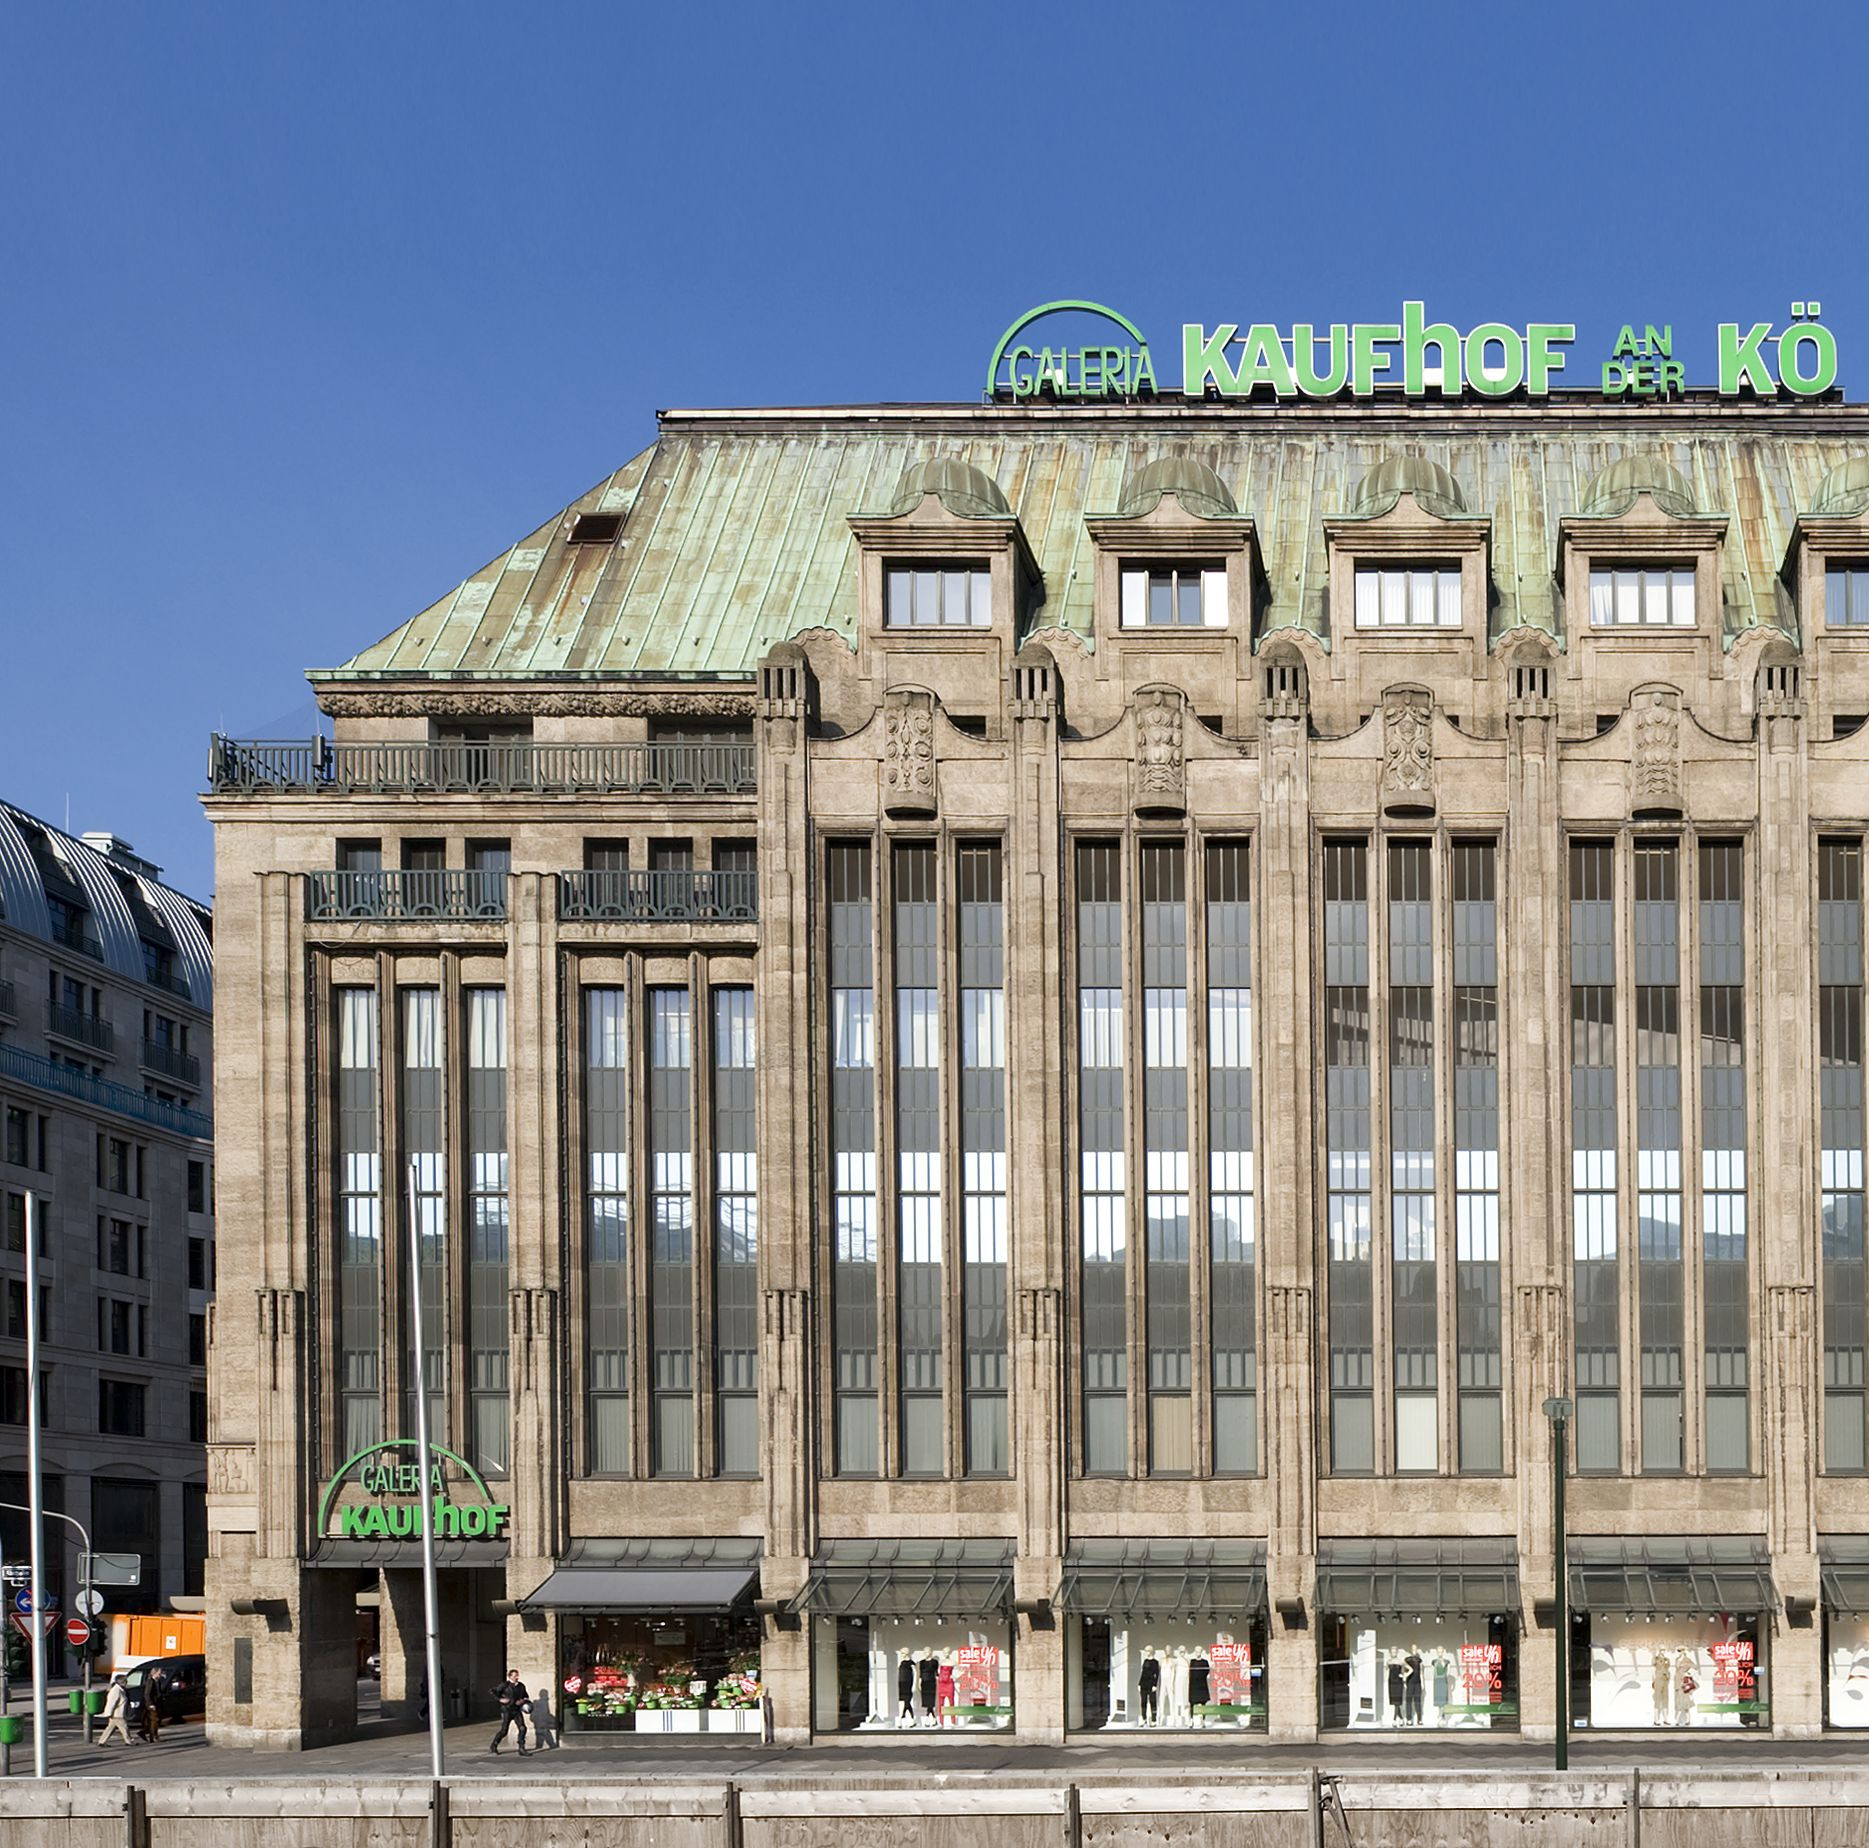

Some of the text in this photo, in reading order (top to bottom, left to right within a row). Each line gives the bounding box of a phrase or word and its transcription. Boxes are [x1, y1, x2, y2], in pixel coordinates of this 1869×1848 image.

[1612, 324, 1672, 357] AN
[1718, 301, 1838, 396] KÖ
[1009, 345, 1158, 396] GALERIA
[1602, 361, 1685, 395] DER
[360, 1464, 444, 1492] GALERA
[960, 1647, 980, 1659] sale
[1212, 1645, 1232, 1657] sale
[1463, 1645, 1483, 1657] sale
[1715, 1642, 1735, 1655] sale
